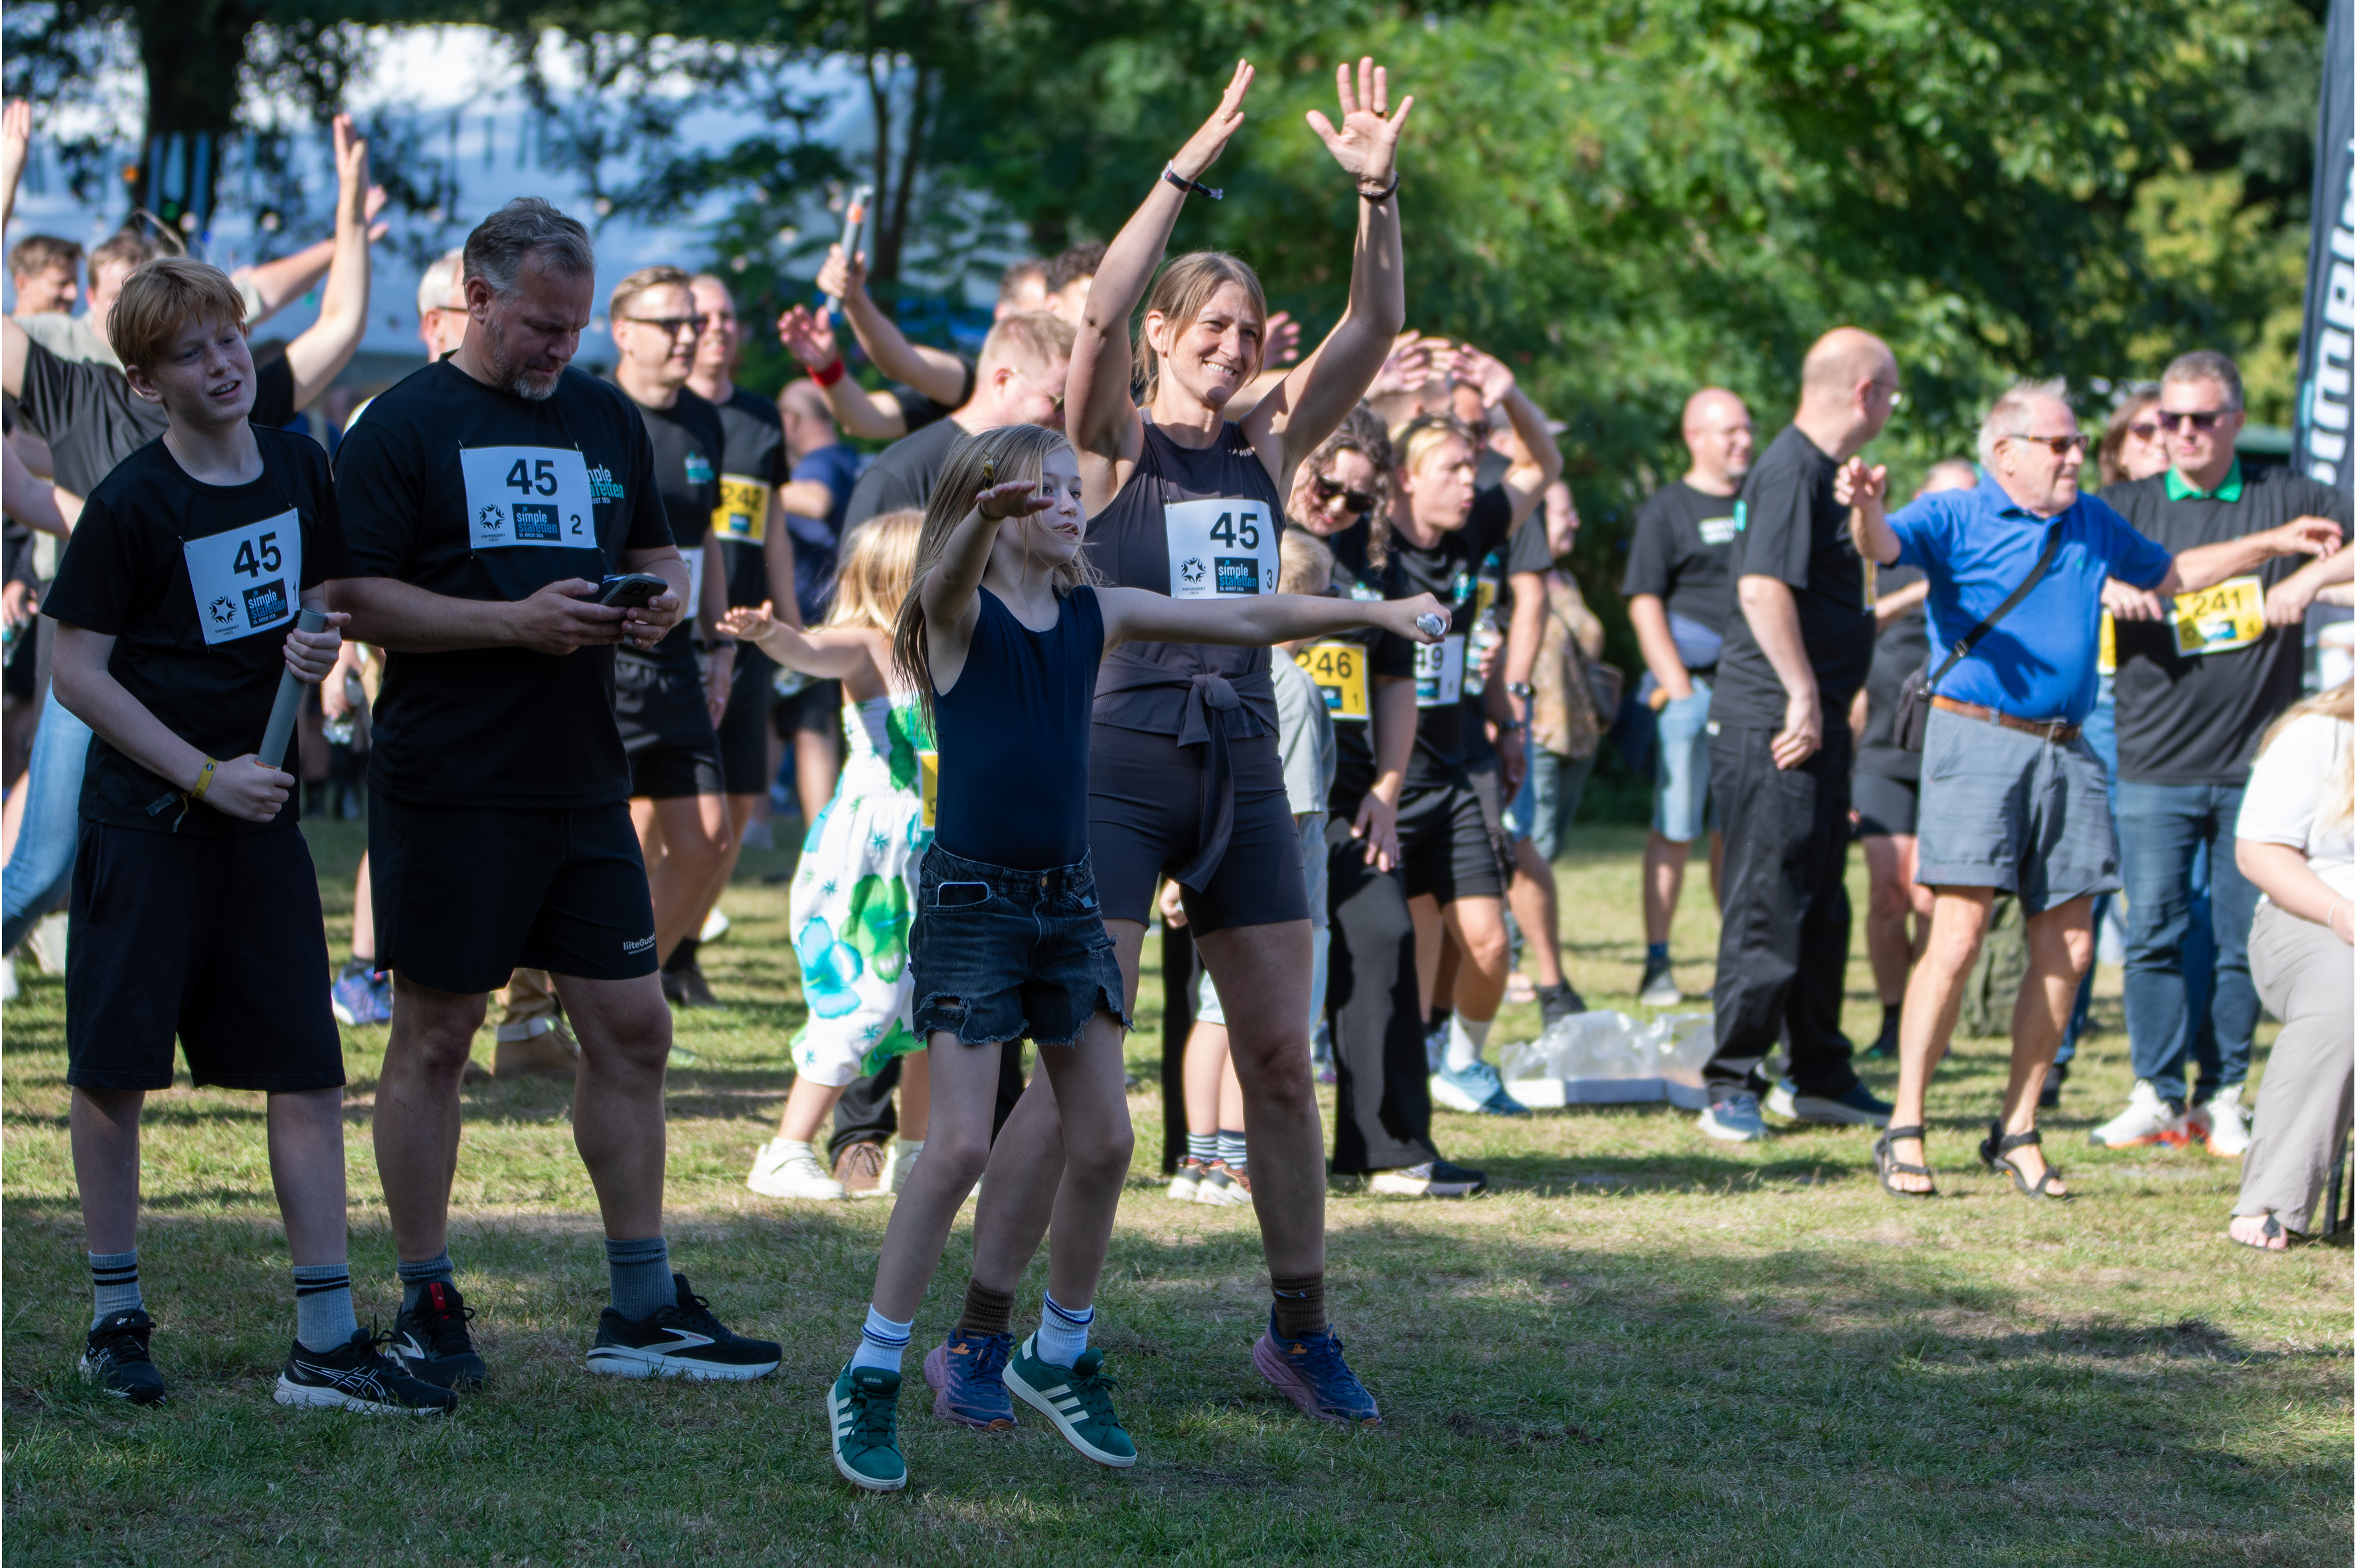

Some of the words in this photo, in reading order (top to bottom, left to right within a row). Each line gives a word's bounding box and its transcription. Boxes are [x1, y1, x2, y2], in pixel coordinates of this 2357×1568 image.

[505, 459, 558, 497] 45
[517, 509, 547, 526] simple
[519, 520, 558, 534] stafetten
[570, 514, 582, 535] 2
[1210, 512, 1259, 550] 45
[233, 531, 282, 578] 45
[1218, 562, 1248, 580] simple
[1266, 569, 1273, 589] 3
[293, 581, 297, 602] 1
[1219, 575, 1257, 588] stafetten
[248, 589, 277, 609] simple
[251, 599, 286, 619] stafetten
[2192, 589, 2241, 618] 241
[2246, 622, 2255, 633] 4
[1295, 651, 1352, 678] 246
[1447, 681, 1453, 695] 1
[1352, 694, 1358, 708] 1
[687, 1334, 708, 1342] BROOKS
